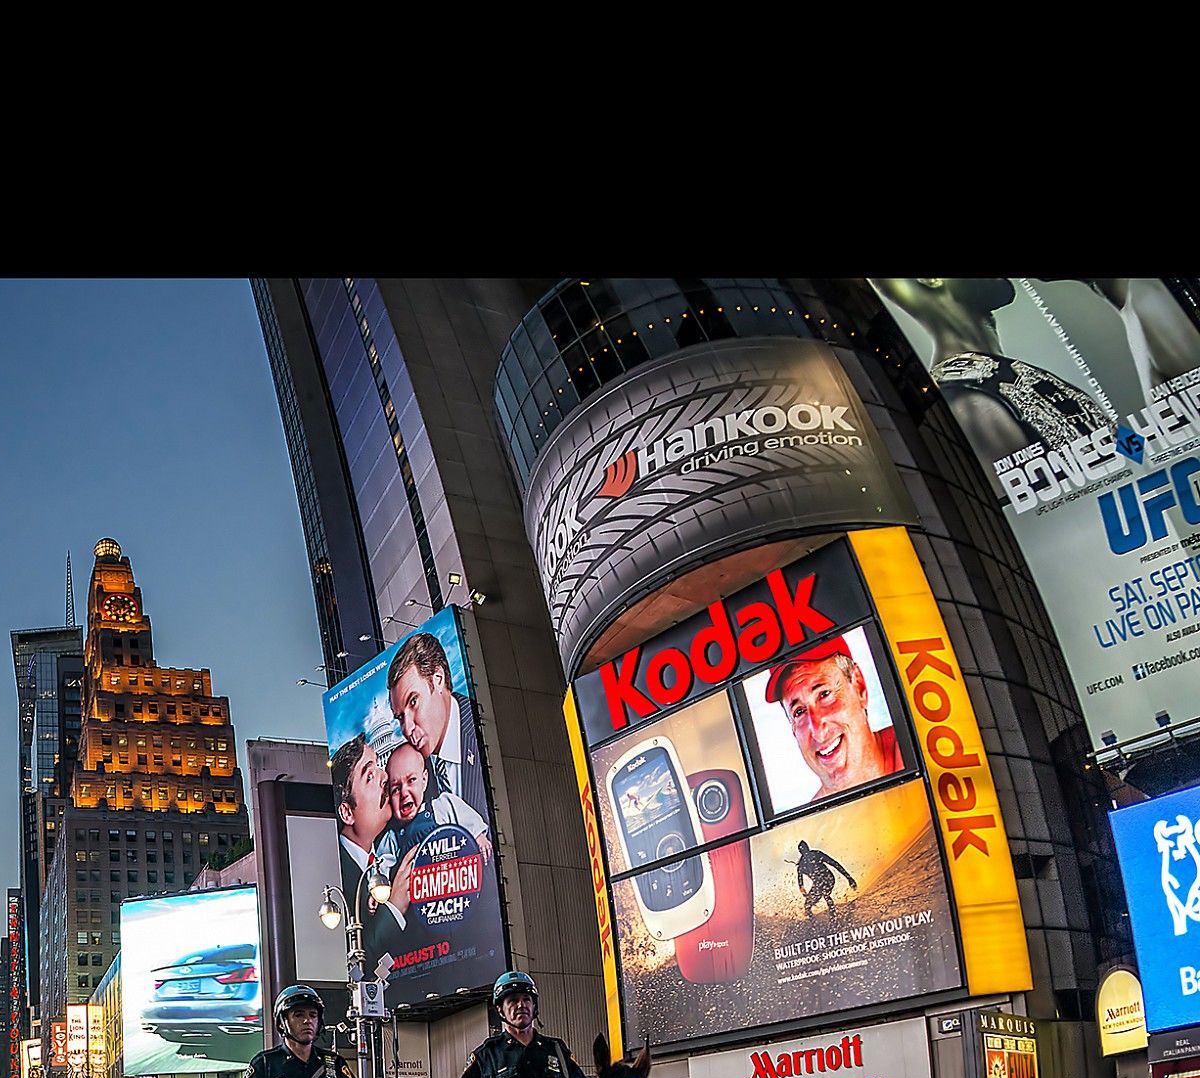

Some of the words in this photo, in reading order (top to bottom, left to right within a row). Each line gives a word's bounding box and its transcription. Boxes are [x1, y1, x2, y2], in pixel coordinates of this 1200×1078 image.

[1065, 344, 1091, 376] LIGHT
[680, 438, 765, 475] driving
[764, 431, 863, 448] emotion
[993, 458, 1014, 475] JON
[1013, 441, 1045, 466] JONES
[1118, 434, 1141, 456] VS
[999, 427, 1127, 515] BONES
[1140, 546, 1172, 564] PRESENTED
[1171, 544, 1180, 555] BY
[1108, 577, 1153, 613] SAT.
[1093, 610, 1145, 648] LIVE
[1143, 598, 1177, 631] ON
[600, 567, 840, 733] Kodak
[1086, 674, 1125, 695] UFC.COM
[895, 635, 997, 861] Kodak
[627, 756, 647, 773] Kodak
[427, 836, 461, 857] WILL
[431, 852, 458, 863] FERRELL
[413, 864, 478, 900] CAMPAIGN
[580, 781, 613, 960] Kodak
[426, 896, 464, 918] ZACH
[774, 943, 802, 961] BUILT
[804, 938, 826, 954] FOR
[827, 930, 849, 948] THE
[849, 922, 876, 941] WAY
[876, 918, 903, 935] YOU
[905, 909, 935, 928] PLAY.
[391, 944, 435, 971] AUGUST
[437, 941, 450, 956] 10
[981, 1014, 1036, 1035] MARQUIS
[1105, 1001, 1141, 1023] Marriott
[68, 1033, 86, 1042] KING
[1176, 1039, 1190, 1047] REAL
